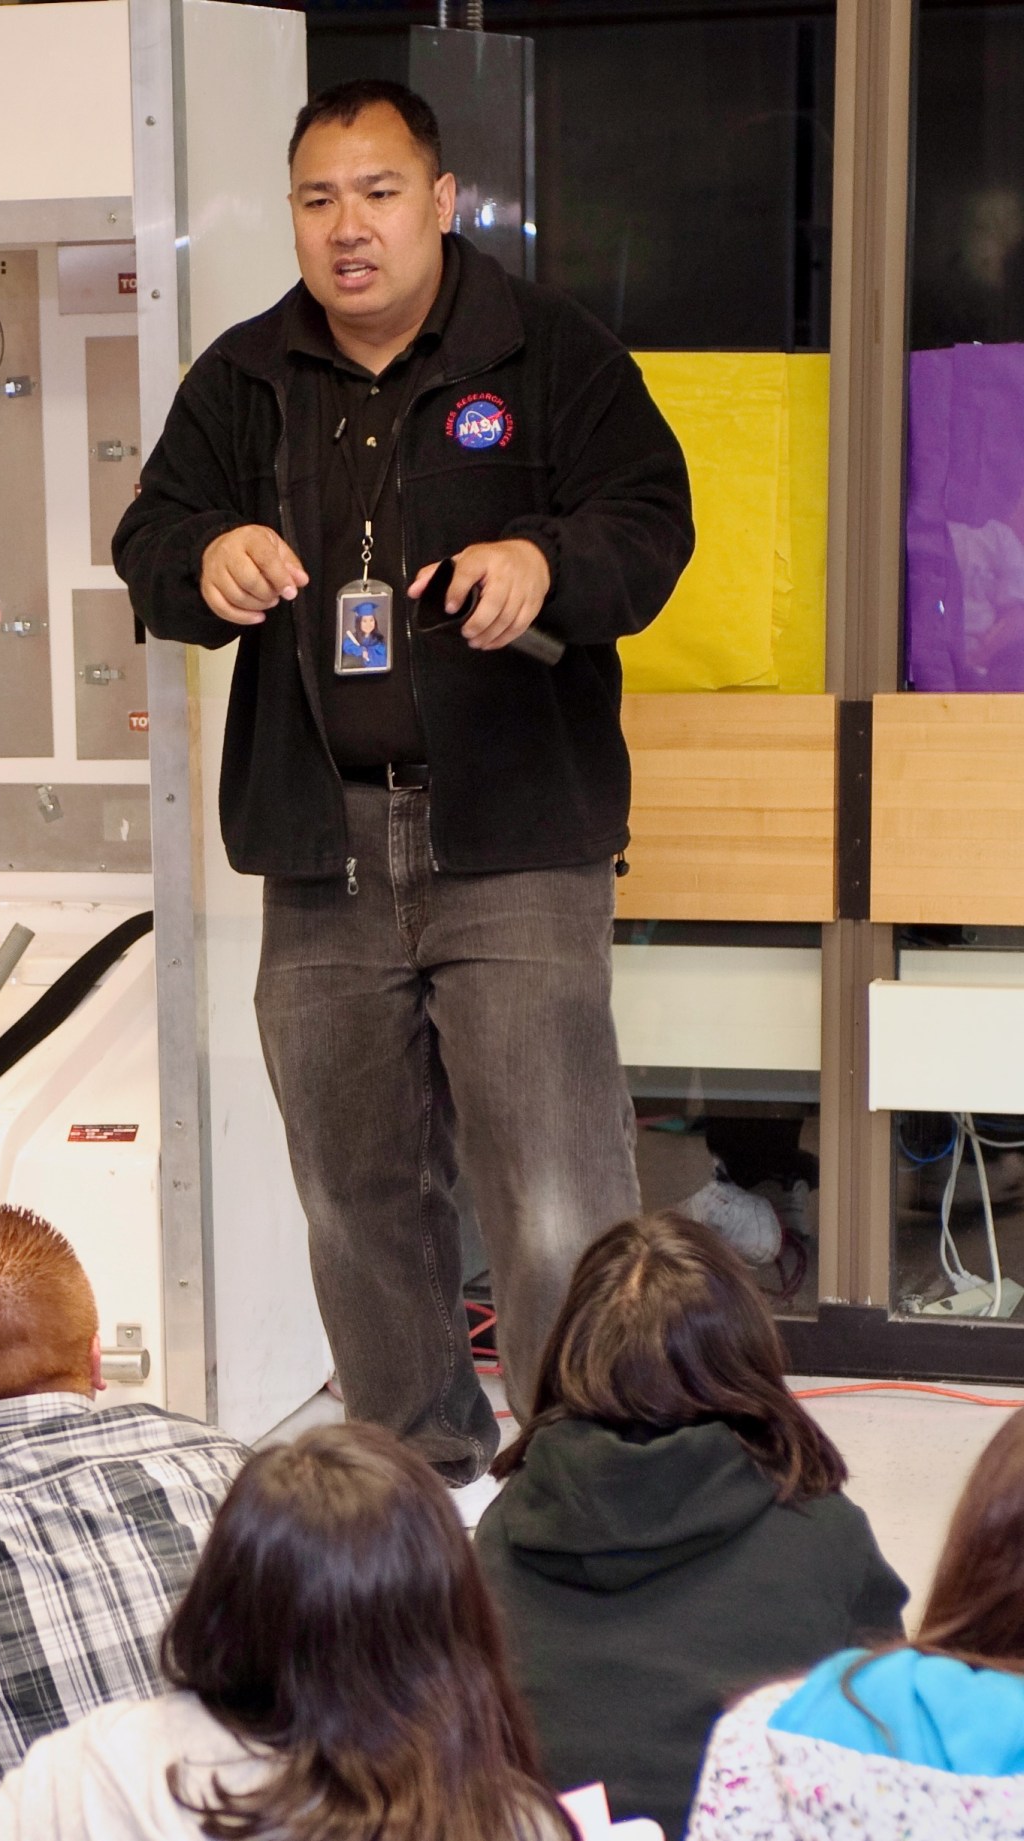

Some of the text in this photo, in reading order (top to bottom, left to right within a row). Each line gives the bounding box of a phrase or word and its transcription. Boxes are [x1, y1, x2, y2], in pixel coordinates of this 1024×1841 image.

[445, 393, 513, 447] AMES RESEARCH CENTER
[459, 419, 502, 436] NASA
